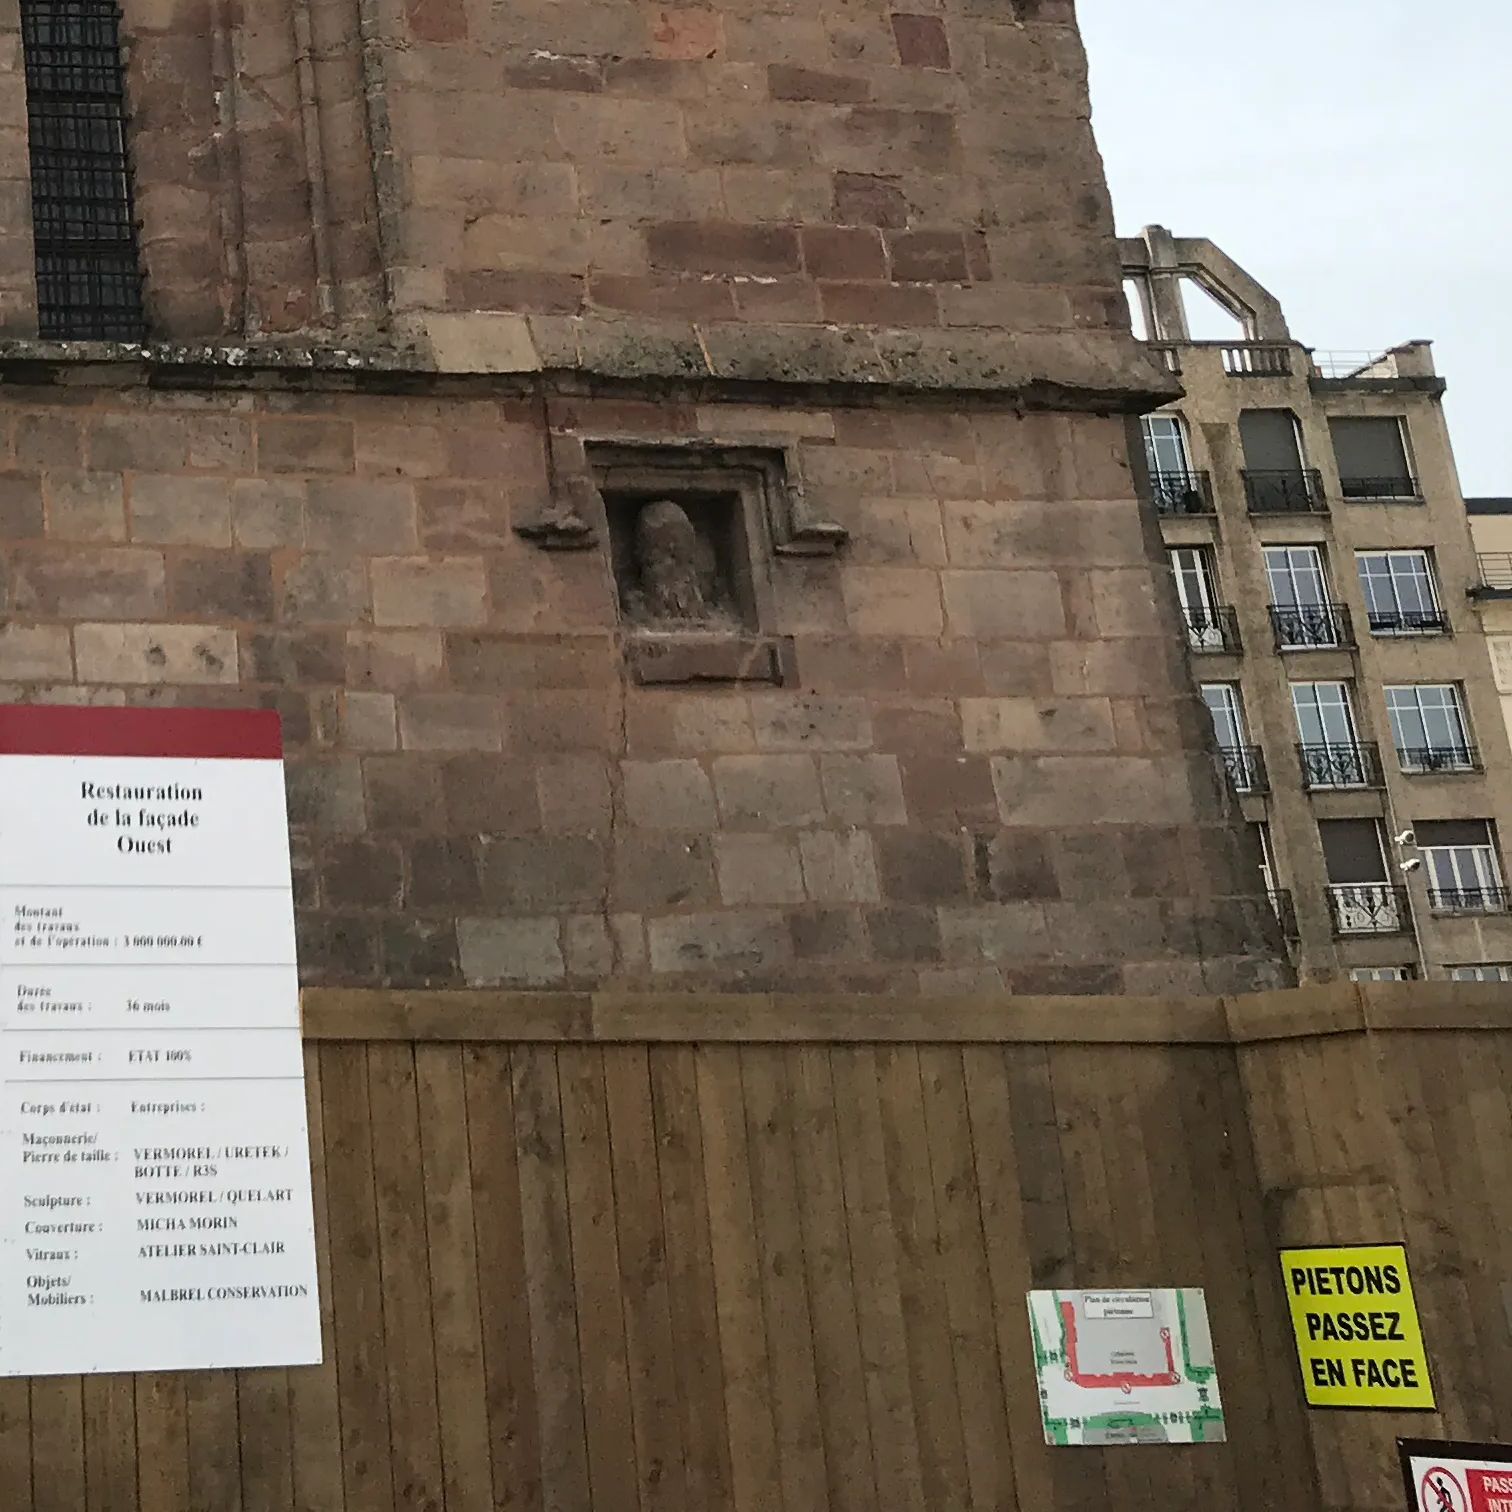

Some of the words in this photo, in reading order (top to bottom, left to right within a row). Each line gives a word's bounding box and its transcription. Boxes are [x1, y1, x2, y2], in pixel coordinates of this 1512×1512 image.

[82, 782, 202, 800] Restauration
[88, 809, 108, 825] de
[116, 809, 130, 826] la
[139, 809, 198, 830] façade
[118, 836, 170, 853] Ouest
[15, 905, 62, 919] Montant
[14, 920, 32, 932] des
[37, 922, 79, 933] travaux
[31, 935, 42, 946] de
[48, 935, 109, 948] l'opération
[18, 985, 51, 998] Durée
[17, 1000, 35, 1012] des
[40, 1002, 82, 1012] travaux
[127, 999, 139, 1012] 36
[143, 1001, 170, 1012] mois
[20, 1051, 92, 1063] Financement
[129, 1050, 159, 1063] ETAT
[167, 1050, 191, 1061] 100%
[21, 1102, 55, 1116] Corps
[60, 1101, 91, 1113] d'état
[131, 1101, 196, 1114] Entreprises
[23, 1151, 60, 1163] Pierre
[64, 1150, 77, 1162] de
[81, 1149, 110, 1162] taille
[134, 1148, 214, 1160] VERMOREL
[225, 1146, 280, 1158] URETEK
[135, 1165, 181, 1178] BOTTE
[194, 1164, 217, 1177] R3S
[24, 1195, 82, 1210] Sculpture
[136, 1191, 216, 1204] VERMOREL
[227, 1189, 291, 1204] QUELART
[25, 1222, 95, 1233] Couverture
[138, 1218, 186, 1230] MICHA
[190, 1217, 237, 1229] MORIN
[26, 1248, 70, 1261] Vitraux
[140, 1244, 196, 1257] ATELIER
[200, 1241, 284, 1255] SAINT-CLAIR
[1291, 1265, 1401, 1296] PIETONS
[28, 1293, 86, 1305] Mobiliers
[141, 1289, 205, 1302] MALBREL
[208, 1285, 307, 1299] CONSERVATION
[1306, 1312, 1405, 1341] PASSEZ
[1310, 1359, 1346, 1387] EN
[1352, 1357, 1419, 1388] FACE
